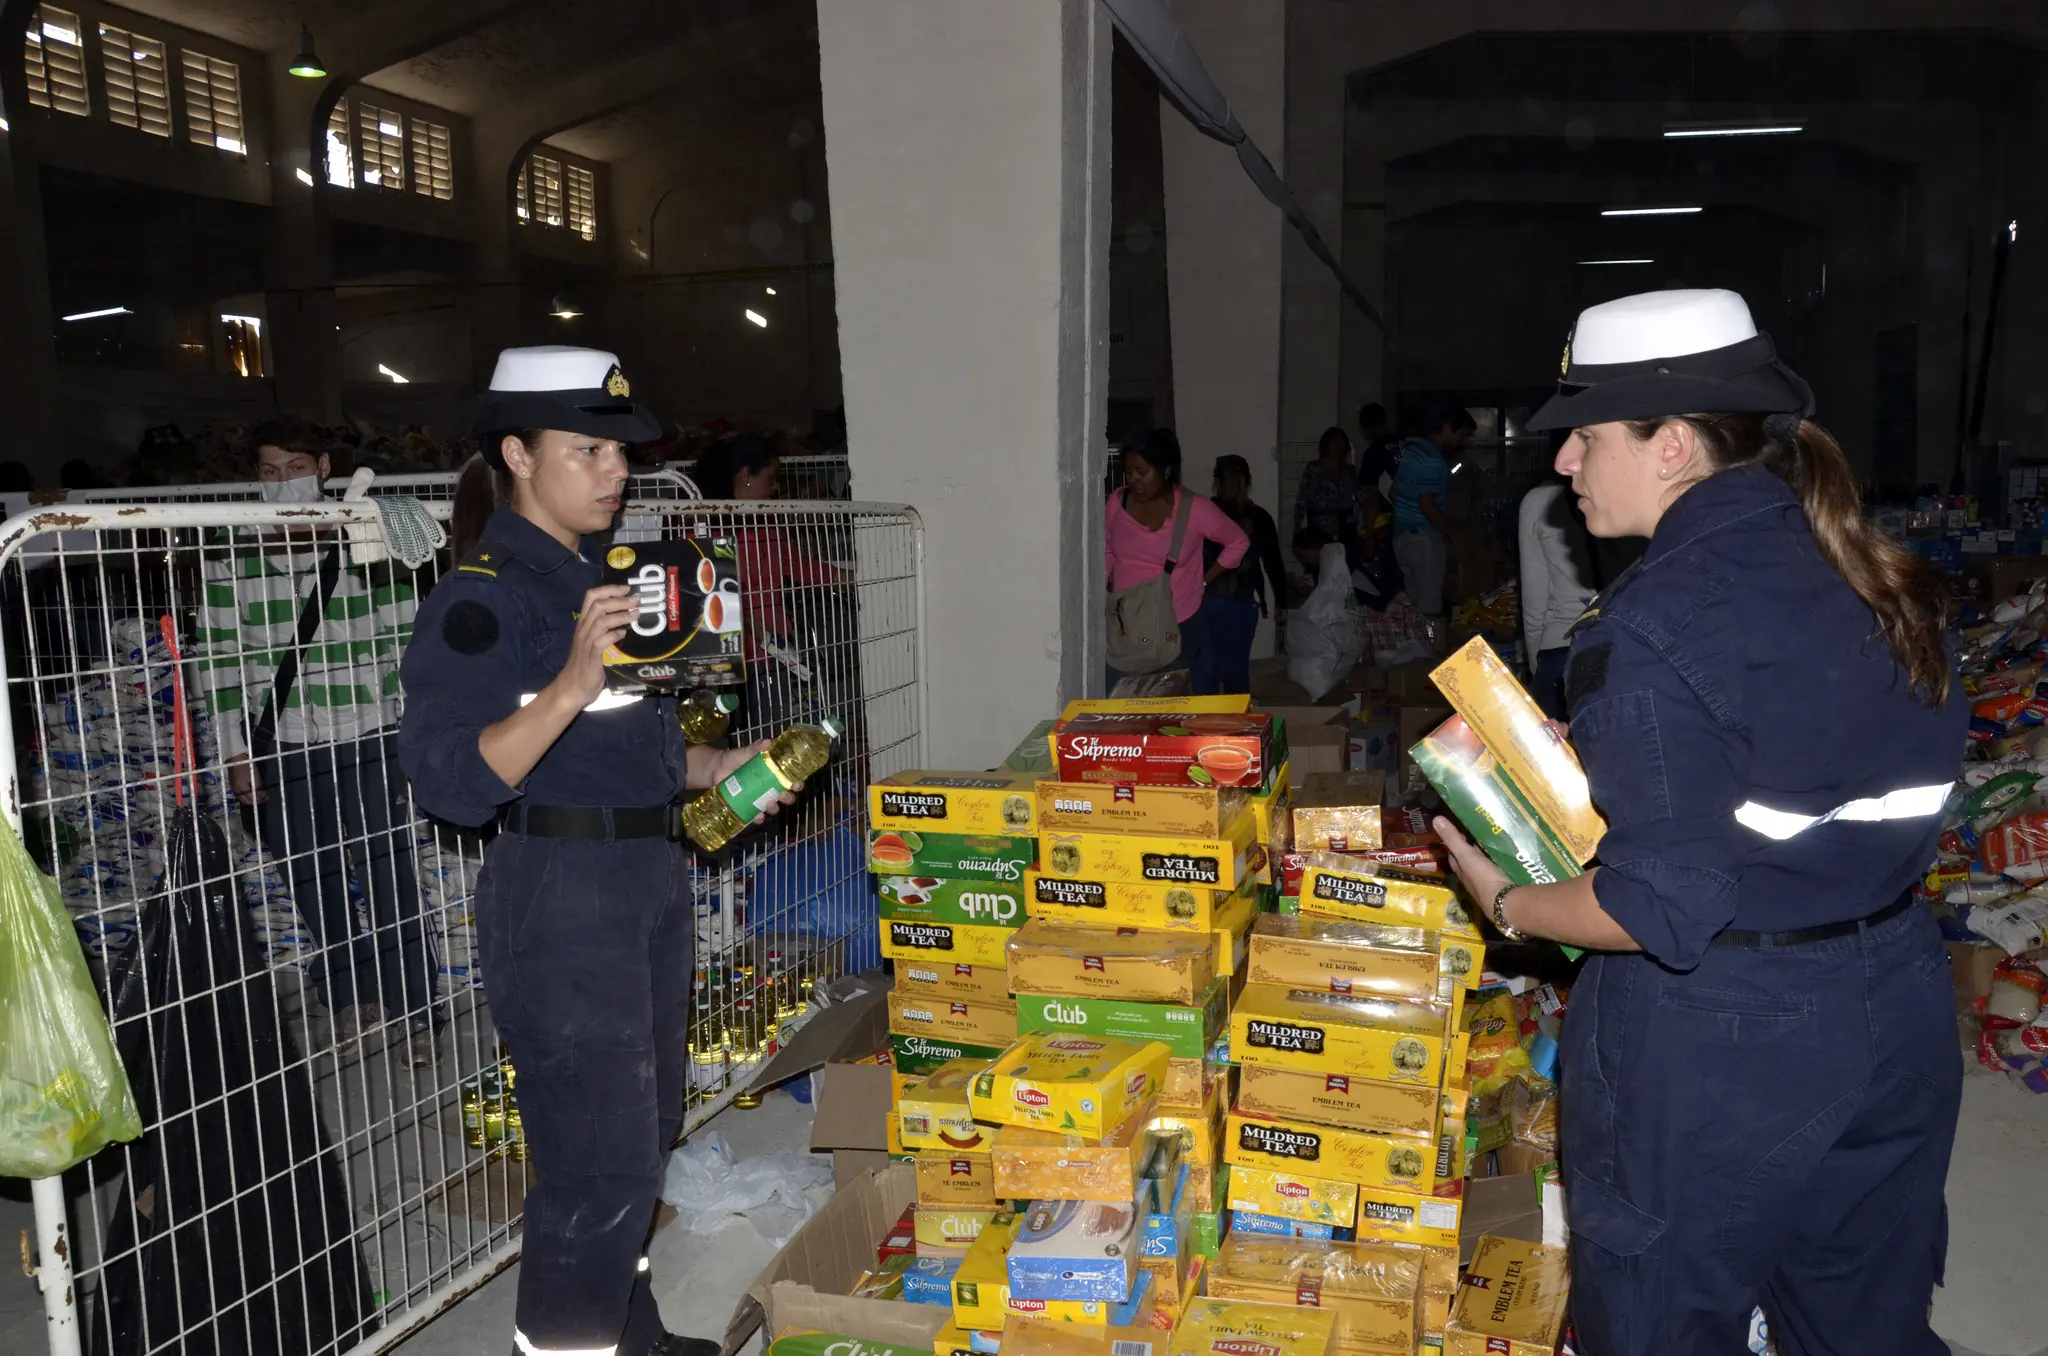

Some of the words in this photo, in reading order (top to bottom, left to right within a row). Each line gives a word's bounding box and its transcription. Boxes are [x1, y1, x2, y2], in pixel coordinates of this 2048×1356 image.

[637, 664, 677, 677] Club
[1064, 736, 1143, 761] Supremo
[1090, 737, 1100, 747] Té
[883, 794, 944, 806] MILDRED
[898, 803, 929, 815] TEA
[1101, 808, 1131, 817] EMBLEM
[1132, 810, 1147, 818] TEA
[1474, 802, 1504, 837] Brasil
[1163, 858, 1198, 870] TEA
[1375, 851, 1417, 865] Supremo
[957, 857, 1027, 881] Supremo
[1145, 867, 1217, 882] MILDRED
[1037, 880, 1104, 894] MILDRED
[1317, 876, 1385, 895] MILDRED
[1054, 891, 1087, 904] TEA
[1333, 888, 1367, 903] TEA
[958, 892, 1018, 920] Club
[892, 924, 951, 938] MILDRED
[907, 934, 937, 946] TEA
[1318, 961, 1335, 970] TEA
[1074, 974, 1105, 984] EMBLEM
[1105, 977, 1120, 985] TEA
[970, 983, 983, 991] TEA
[1043, 1002, 1088, 1025] Club
[1250, 1022, 1323, 1041] MILDRED
[899, 1037, 962, 1058] Supremo
[1050, 1040, 1102, 1051] Lipton
[1267, 1034, 1303, 1049] TEA
[1240, 1054, 1259, 1062] 100
[1127, 1073, 1147, 1094] Lipton
[1017, 1090, 1048, 1105] Lipton
[1311, 1095, 1345, 1107] EMBLEM
[1346, 1101, 1362, 1110] TEA
[1013, 1104, 1036, 1115] YELLOW
[1037, 1109, 1056, 1119] LABEL
[1030, 1113, 1041, 1121] TEA
[1243, 1125, 1318, 1147] MILDRED
[1261, 1138, 1298, 1156] TEA
[1332, 1137, 1377, 1158] Ceylon
[1342, 1156, 1366, 1169] Tea
[1277, 1184, 1309, 1197] Lipton
[1365, 1202, 1413, 1216] MILDRED
[1377, 1210, 1400, 1220] TEA
[940, 1216, 982, 1236] Club
[1440, 1232, 1457, 1240] 100
[906, 1277, 950, 1291] Supremo
[1490, 1280, 1517, 1323] EMBLEM
[1505, 1260, 1525, 1280] TEA
[1010, 1299, 1044, 1311] Lipton
[1216, 1341, 1277, 1356] Lipton
